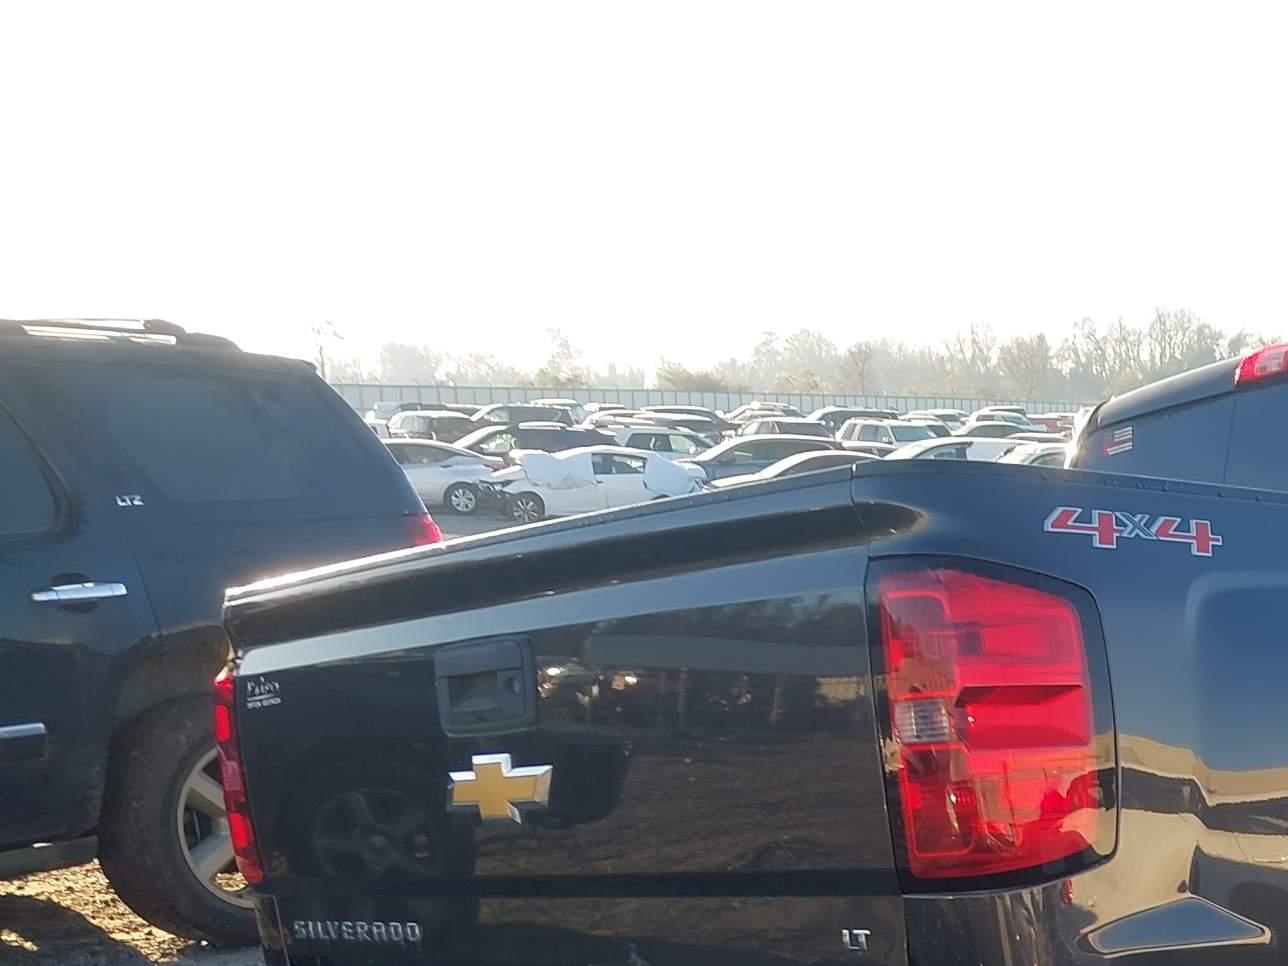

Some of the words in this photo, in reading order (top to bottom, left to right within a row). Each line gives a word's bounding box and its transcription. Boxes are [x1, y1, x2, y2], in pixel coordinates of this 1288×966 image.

[115, 495, 144, 506] LTZ
[292, 920, 421, 941] SILVERADO
[841, 929, 871, 951] LT
